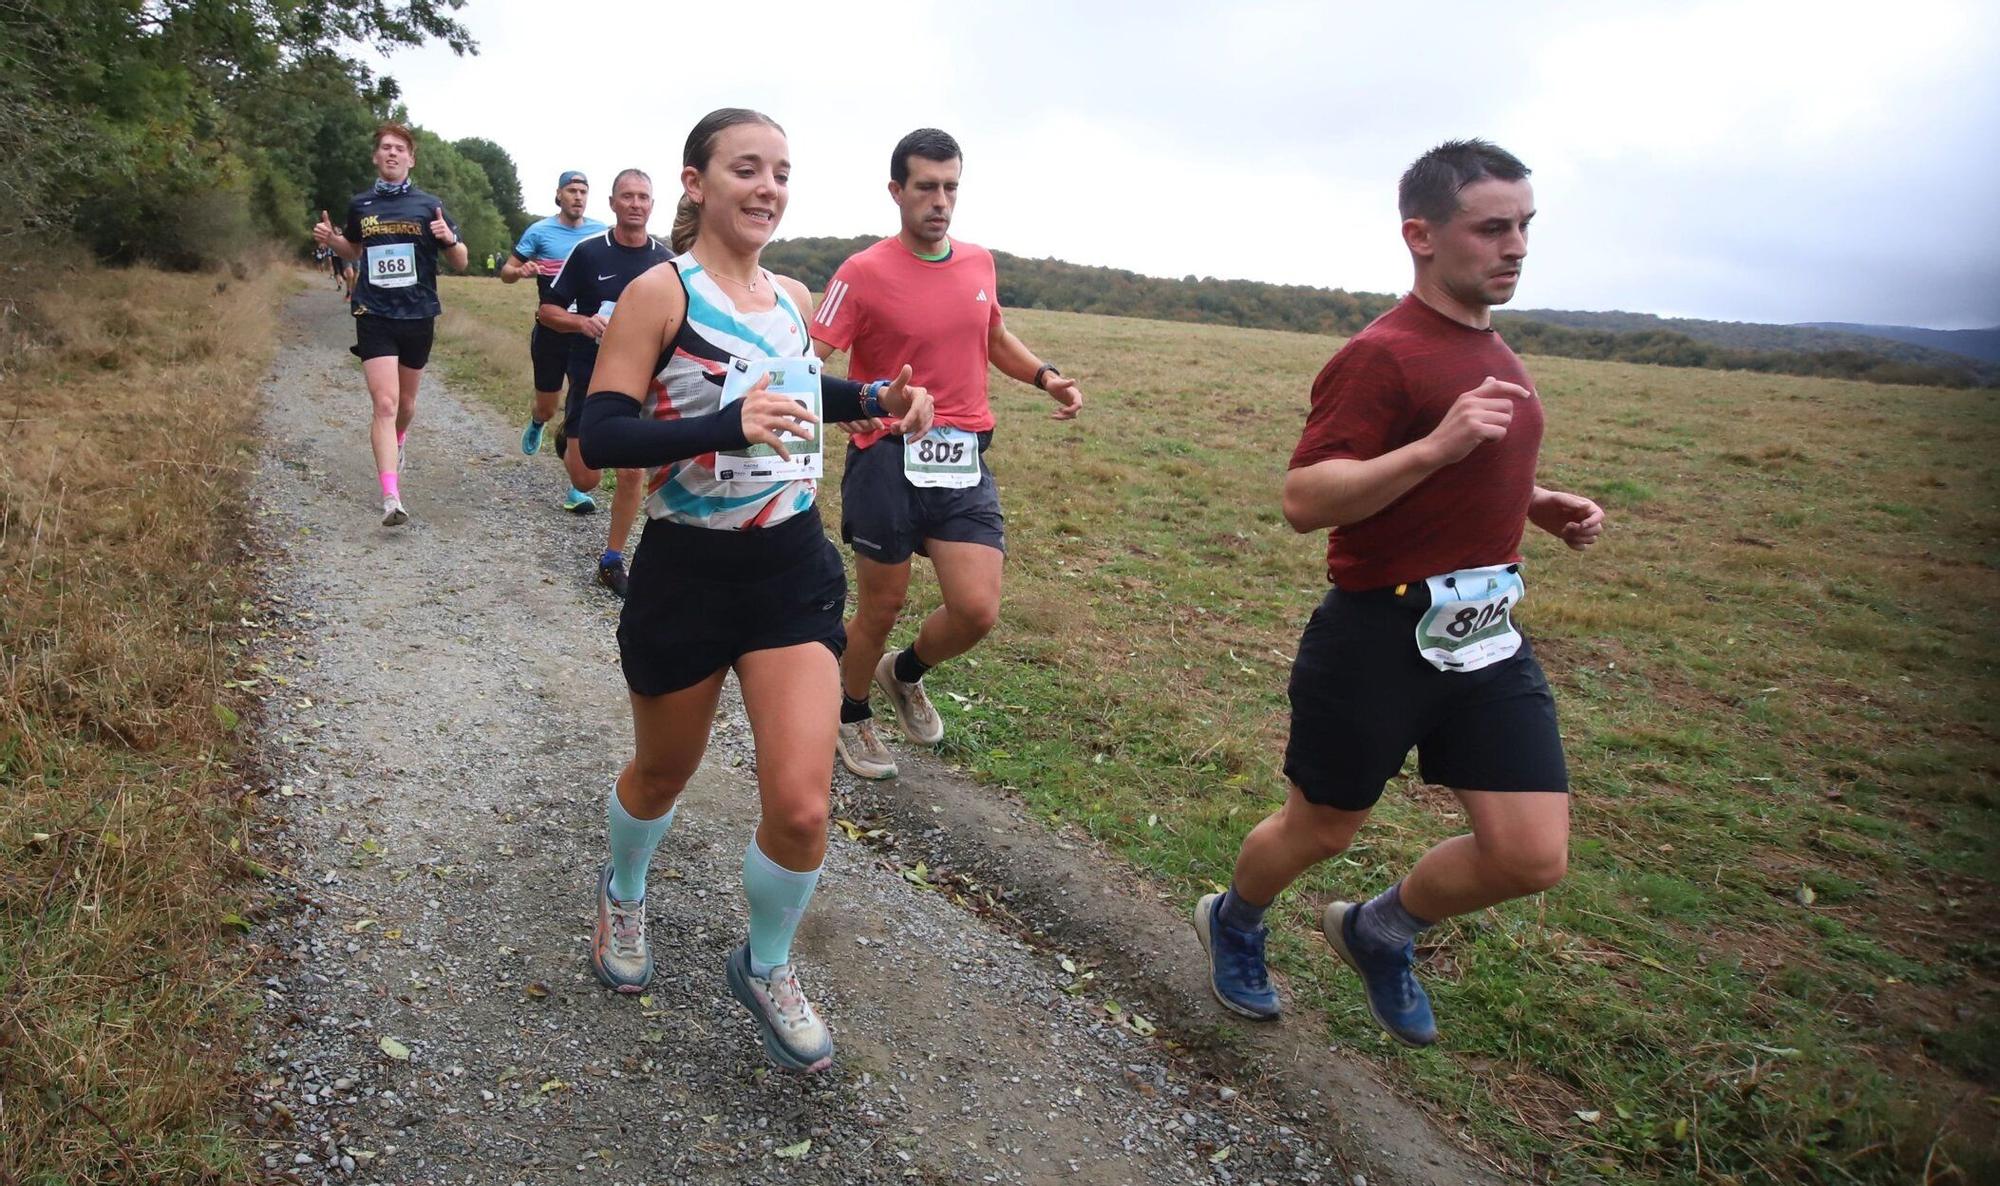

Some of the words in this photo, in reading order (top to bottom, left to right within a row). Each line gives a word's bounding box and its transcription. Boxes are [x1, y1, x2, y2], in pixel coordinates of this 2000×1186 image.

[378, 259, 406, 274] 868
[918, 439, 964, 464] 805
[1446, 596, 1508, 638] 806
